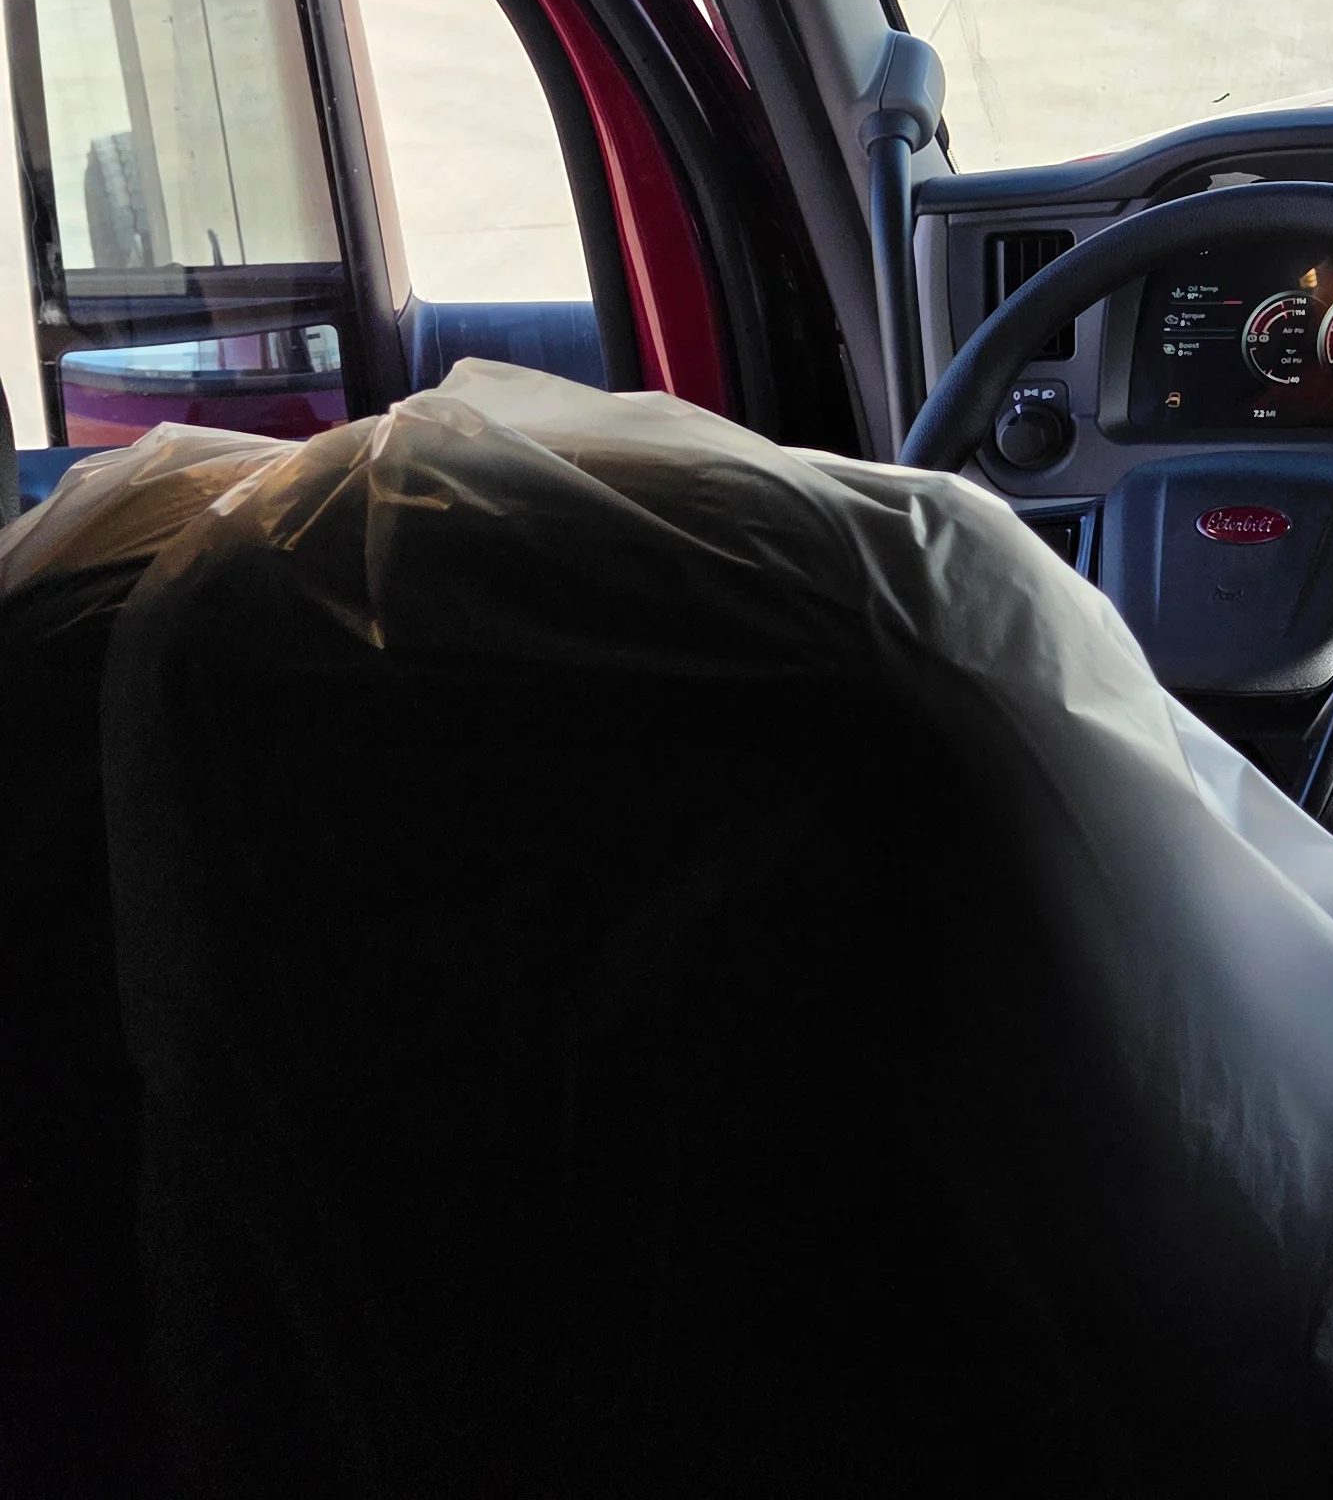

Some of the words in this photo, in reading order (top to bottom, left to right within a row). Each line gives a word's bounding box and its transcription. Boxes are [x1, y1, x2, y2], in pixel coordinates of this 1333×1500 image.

[1187, 285, 1199, 293] Oil
[1200, 285, 1219, 294] Temp
[1181, 312, 1206, 320] Torque
[1178, 342, 1200, 350] Boost
[1206, 510, 1277, 533] Peterbilt
